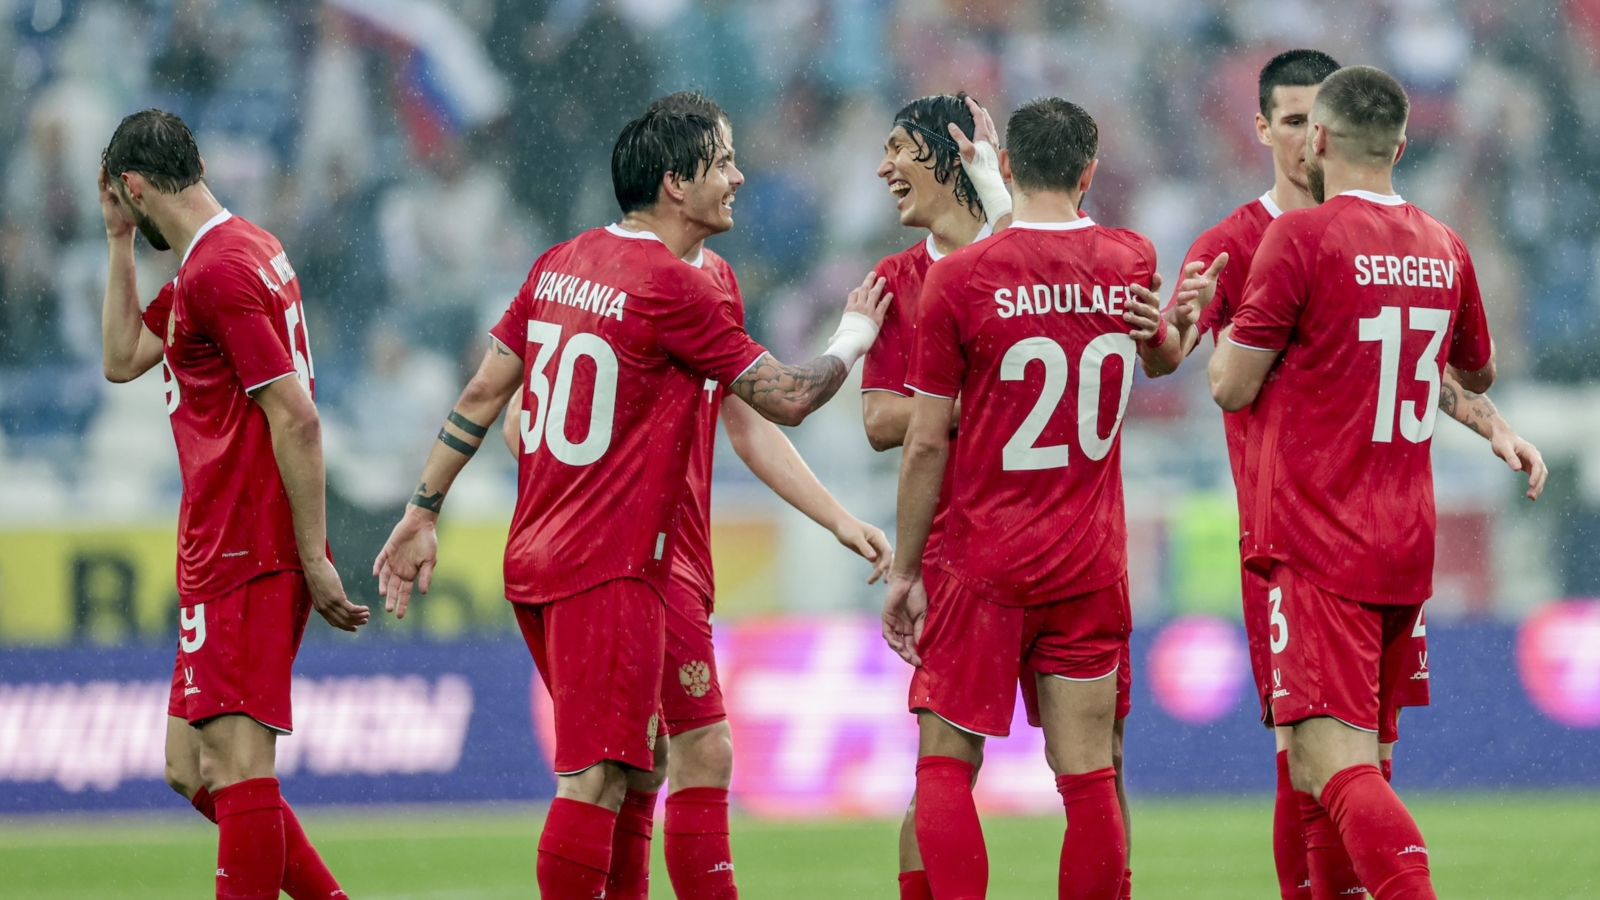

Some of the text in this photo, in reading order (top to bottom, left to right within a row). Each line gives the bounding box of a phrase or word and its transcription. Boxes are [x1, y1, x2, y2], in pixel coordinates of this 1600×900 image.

[533, 271, 627, 322] VAKHANIA
[1354, 254, 1454, 290] SERGEEV
[520, 319, 619, 466] 30
[1000, 332, 1137, 471] 20
[1358, 306, 1451, 444] 13
